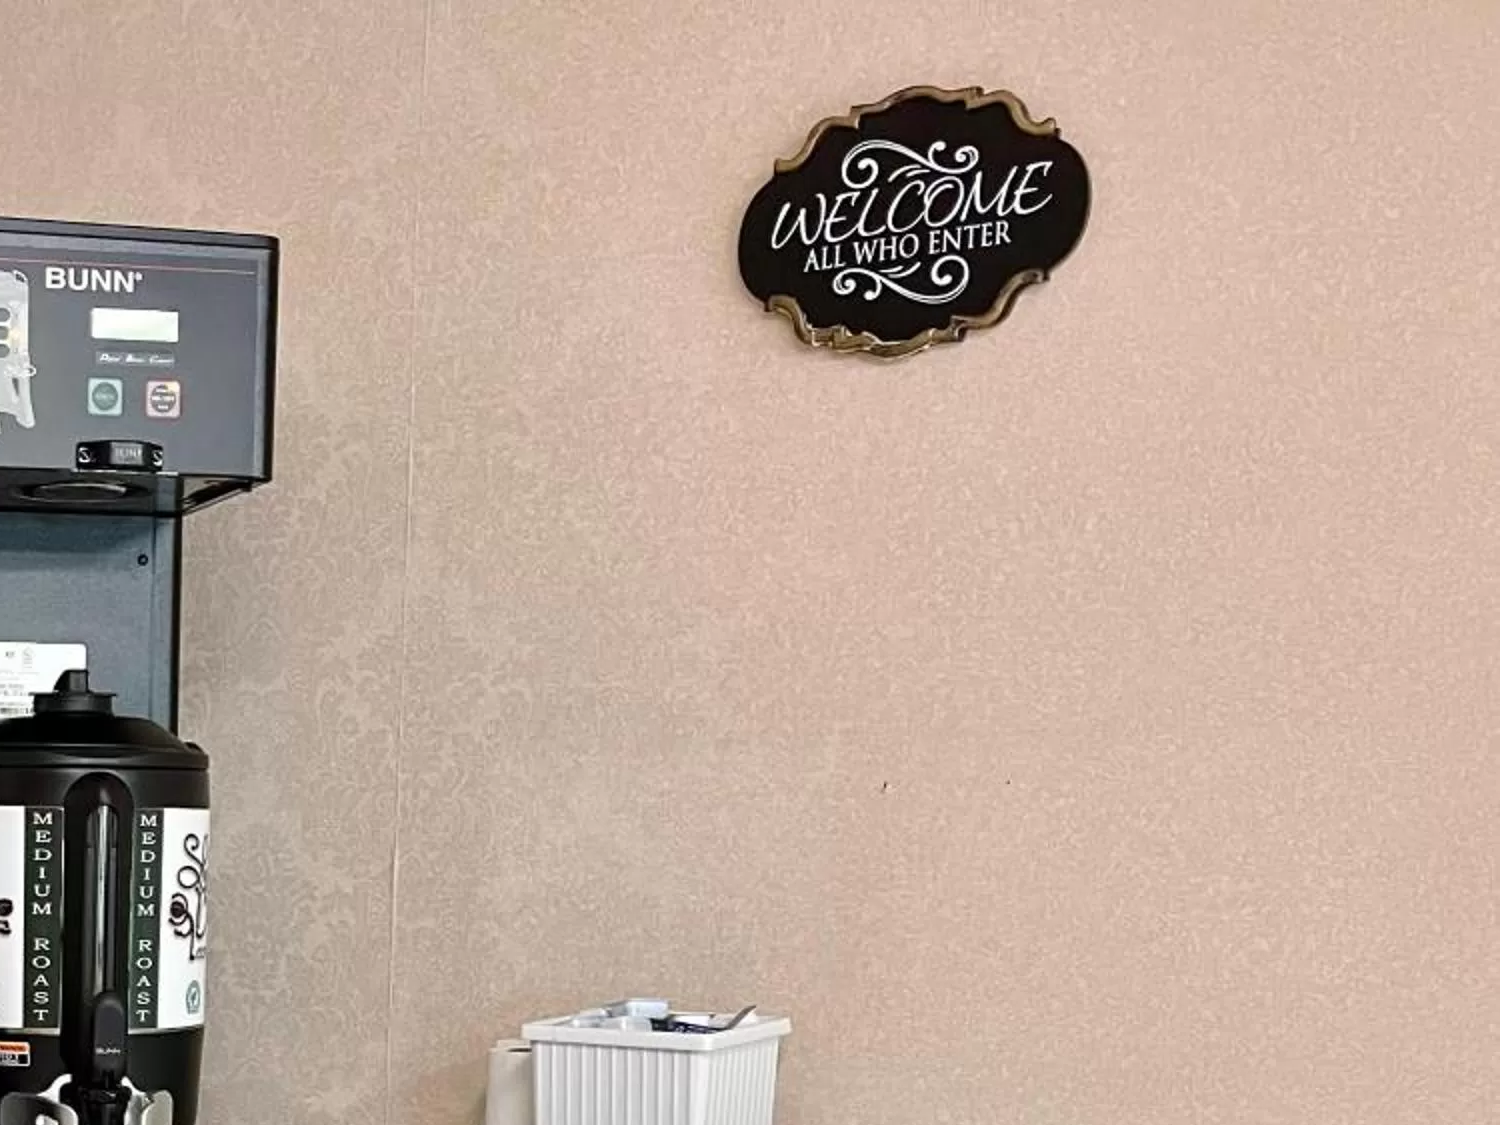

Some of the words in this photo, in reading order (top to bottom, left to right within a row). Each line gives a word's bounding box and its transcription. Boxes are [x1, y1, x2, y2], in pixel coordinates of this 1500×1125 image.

[771, 160, 1053, 249] WELCOME
[45, 266, 135, 293] BUNN
[803, 241, 845, 273] ALL
[854, 233, 919, 265] WHO
[928, 220, 1012, 255] ENTER
[32, 812, 52, 915] MEDIUM
[137, 814, 157, 917] MEDIUM
[32, 938, 51, 1021] ROAST
[135, 940, 153, 1022] ROAST
